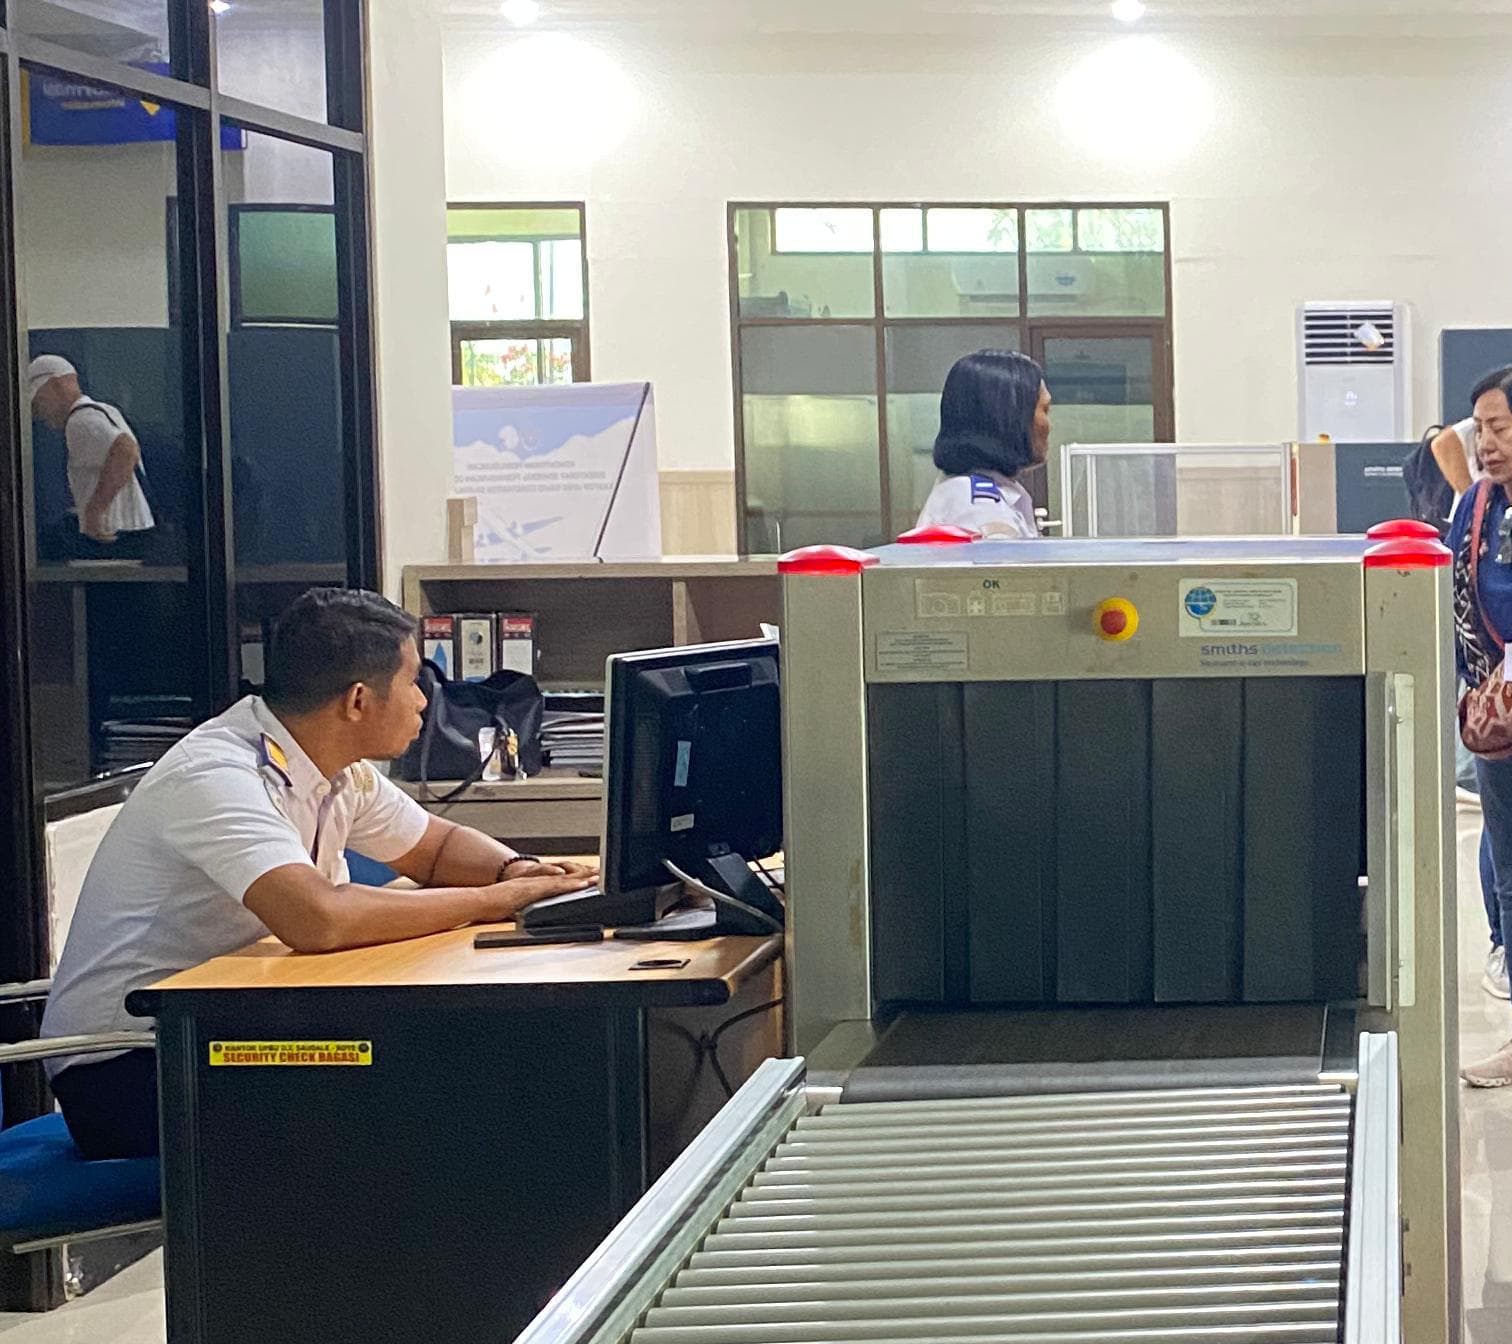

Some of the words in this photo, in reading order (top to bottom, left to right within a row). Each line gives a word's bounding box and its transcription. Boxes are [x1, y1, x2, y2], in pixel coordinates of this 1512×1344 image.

[983, 579, 1000, 589] OK
[1200, 643, 1258, 655] smiths
[224, 1052, 276, 1063] SECURITY
[279, 1052, 315, 1063] CHECK
[317, 1052, 360, 1063] BAGASI
